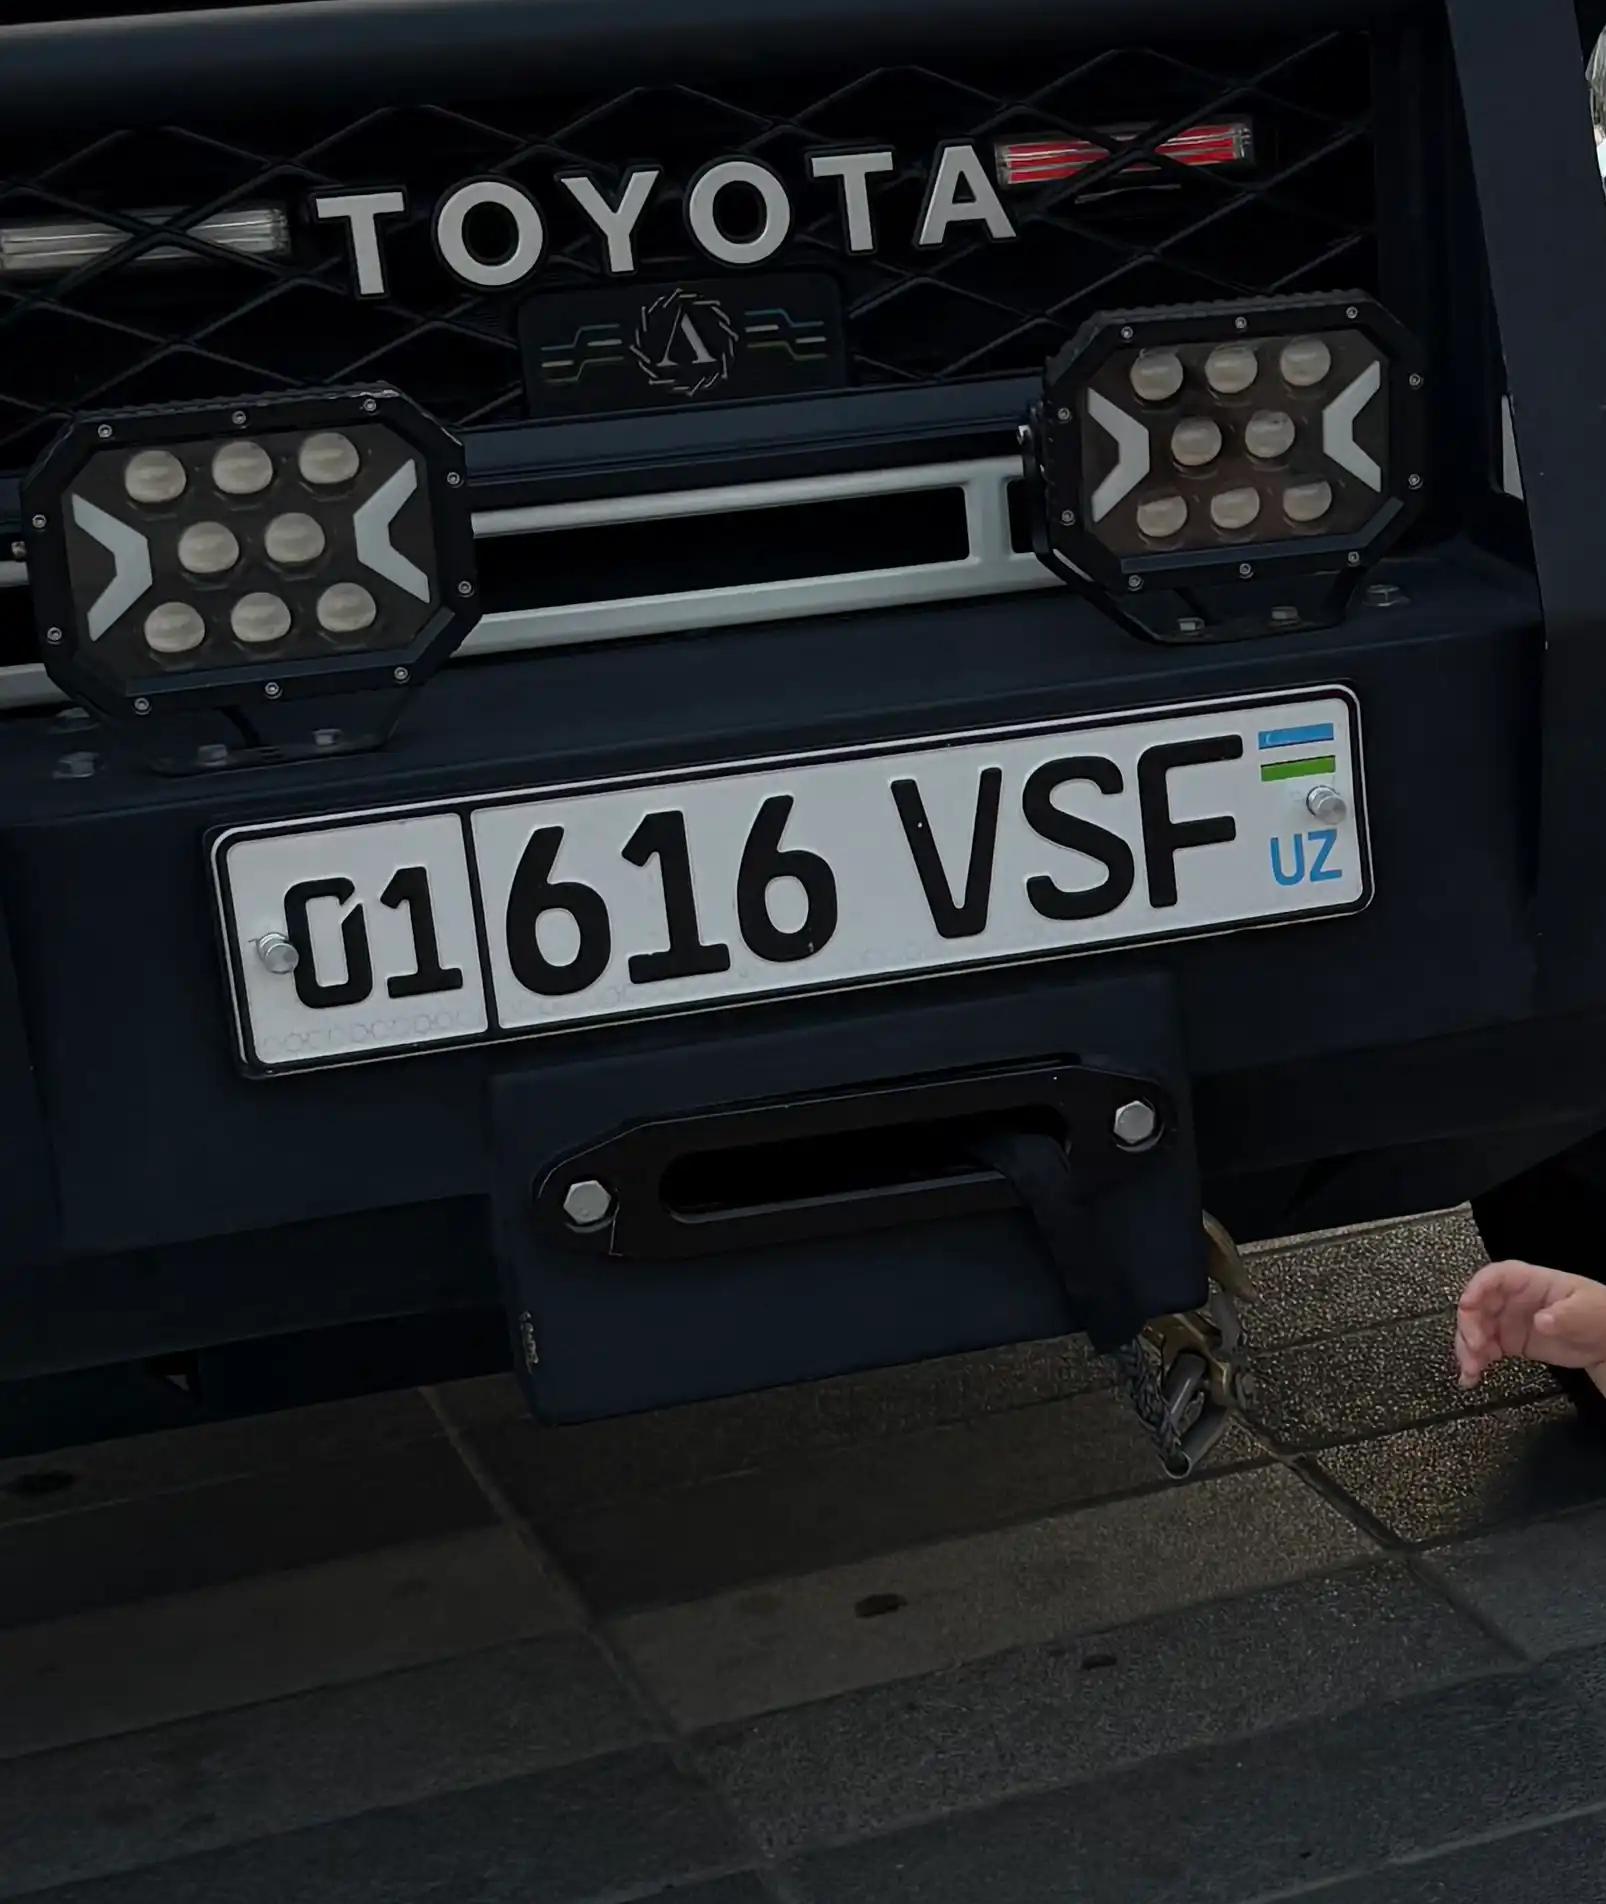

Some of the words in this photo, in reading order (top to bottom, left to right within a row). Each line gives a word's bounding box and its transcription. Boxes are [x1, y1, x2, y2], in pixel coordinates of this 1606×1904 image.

[315, 142, 1016, 296] TOYOTA
[282, 866, 464, 1010] 01
[505, 794, 839, 999] 616
[888, 734, 1244, 940] VSF
[1268, 830, 1343, 887] UZ
